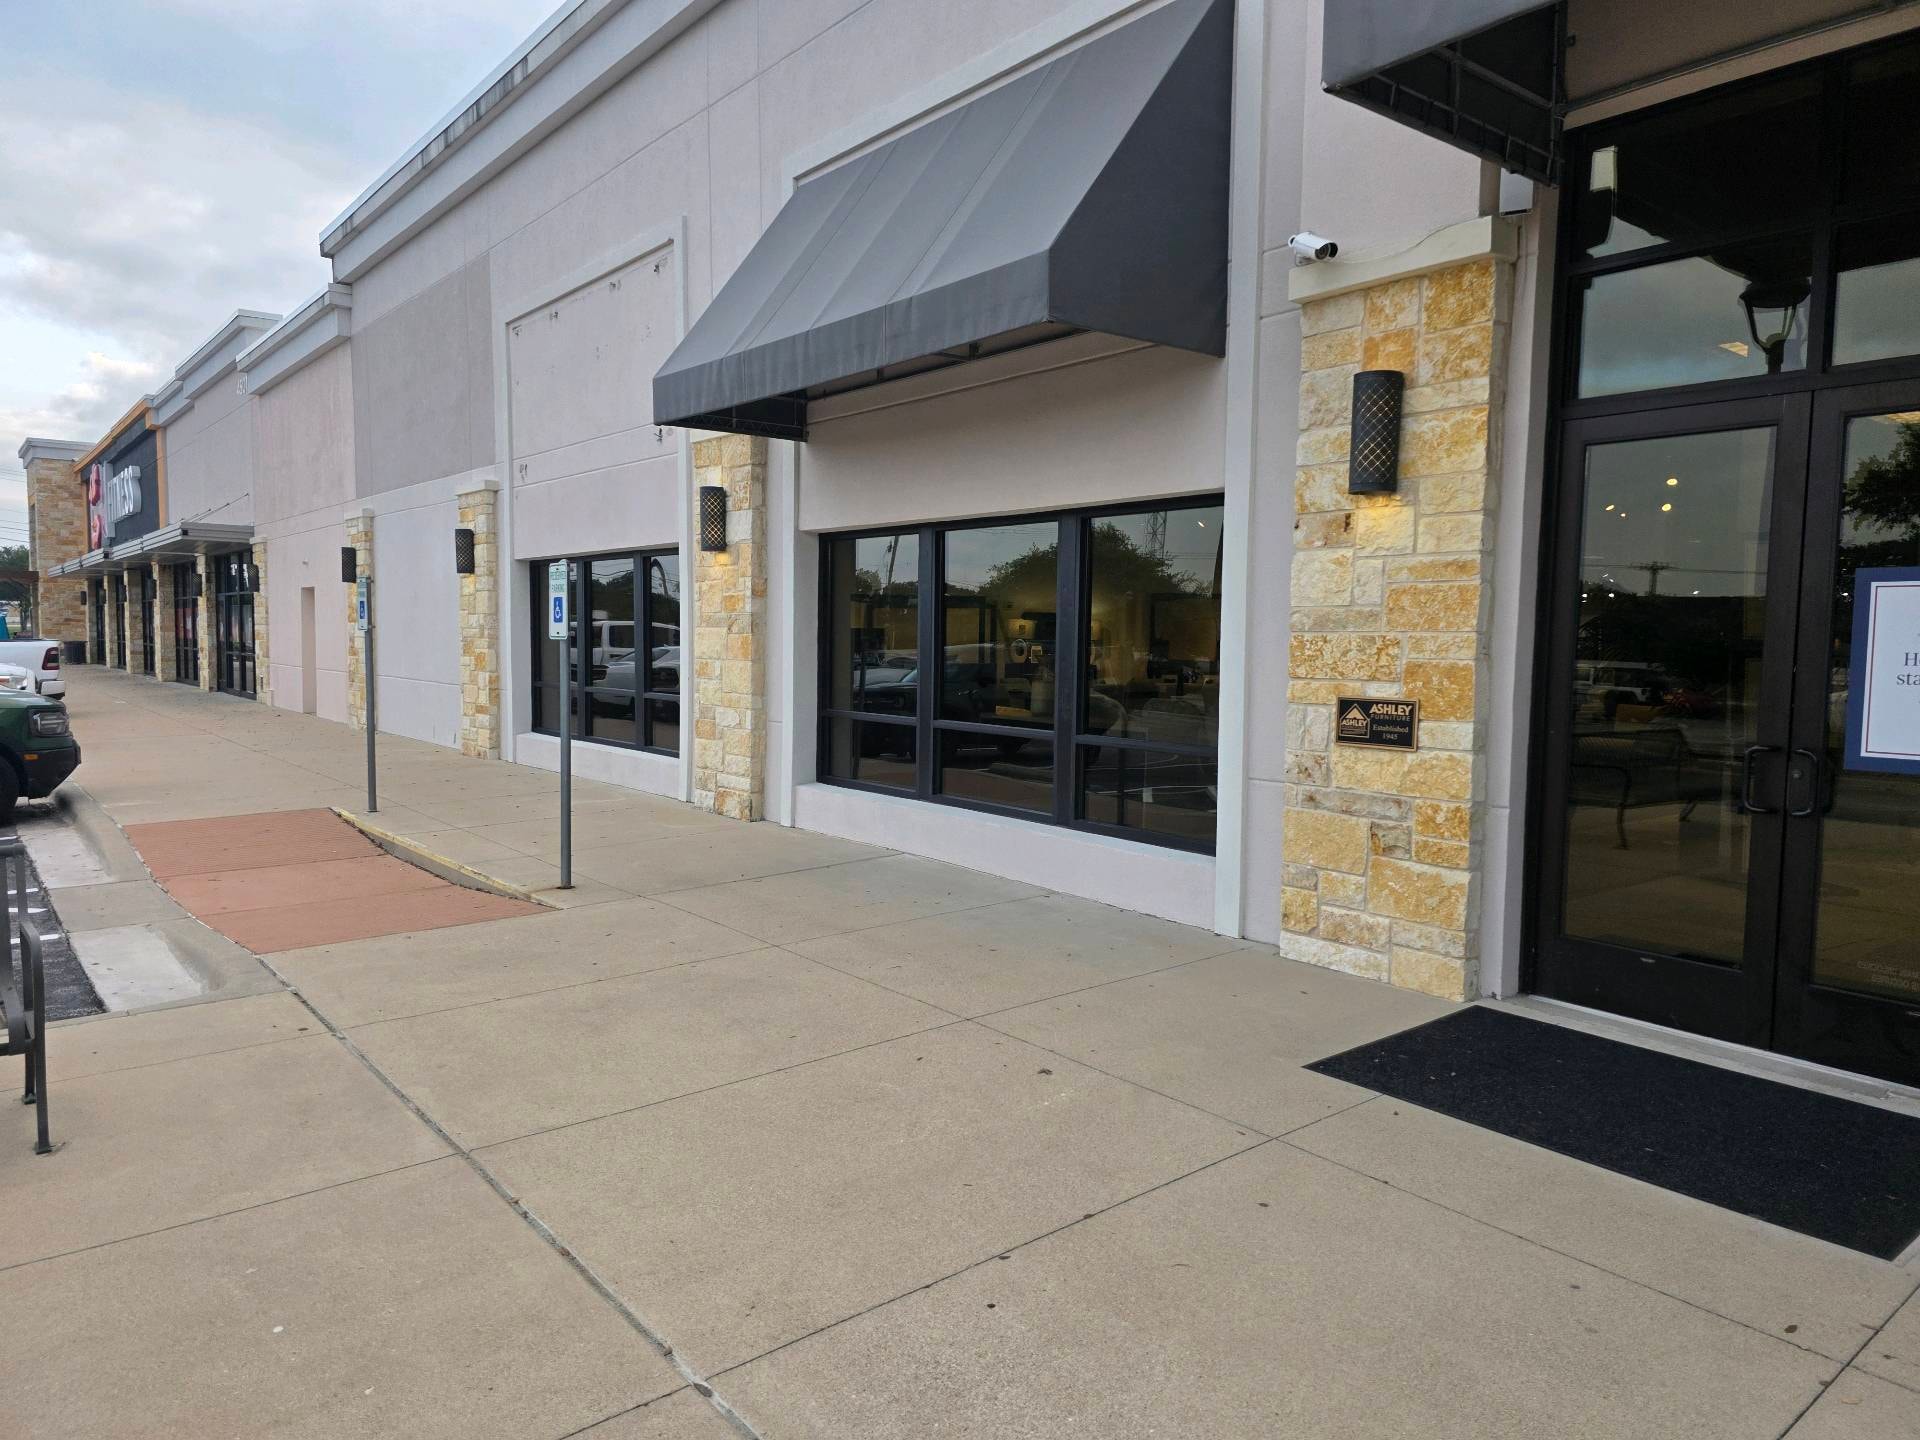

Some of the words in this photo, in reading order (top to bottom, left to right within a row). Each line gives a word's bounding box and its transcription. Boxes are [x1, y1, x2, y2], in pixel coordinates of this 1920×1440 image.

[1369, 704, 1413, 716] ASHLEY
[1370, 714, 1411, 722] FURNITURE
[1373, 724, 1409, 733] Established
